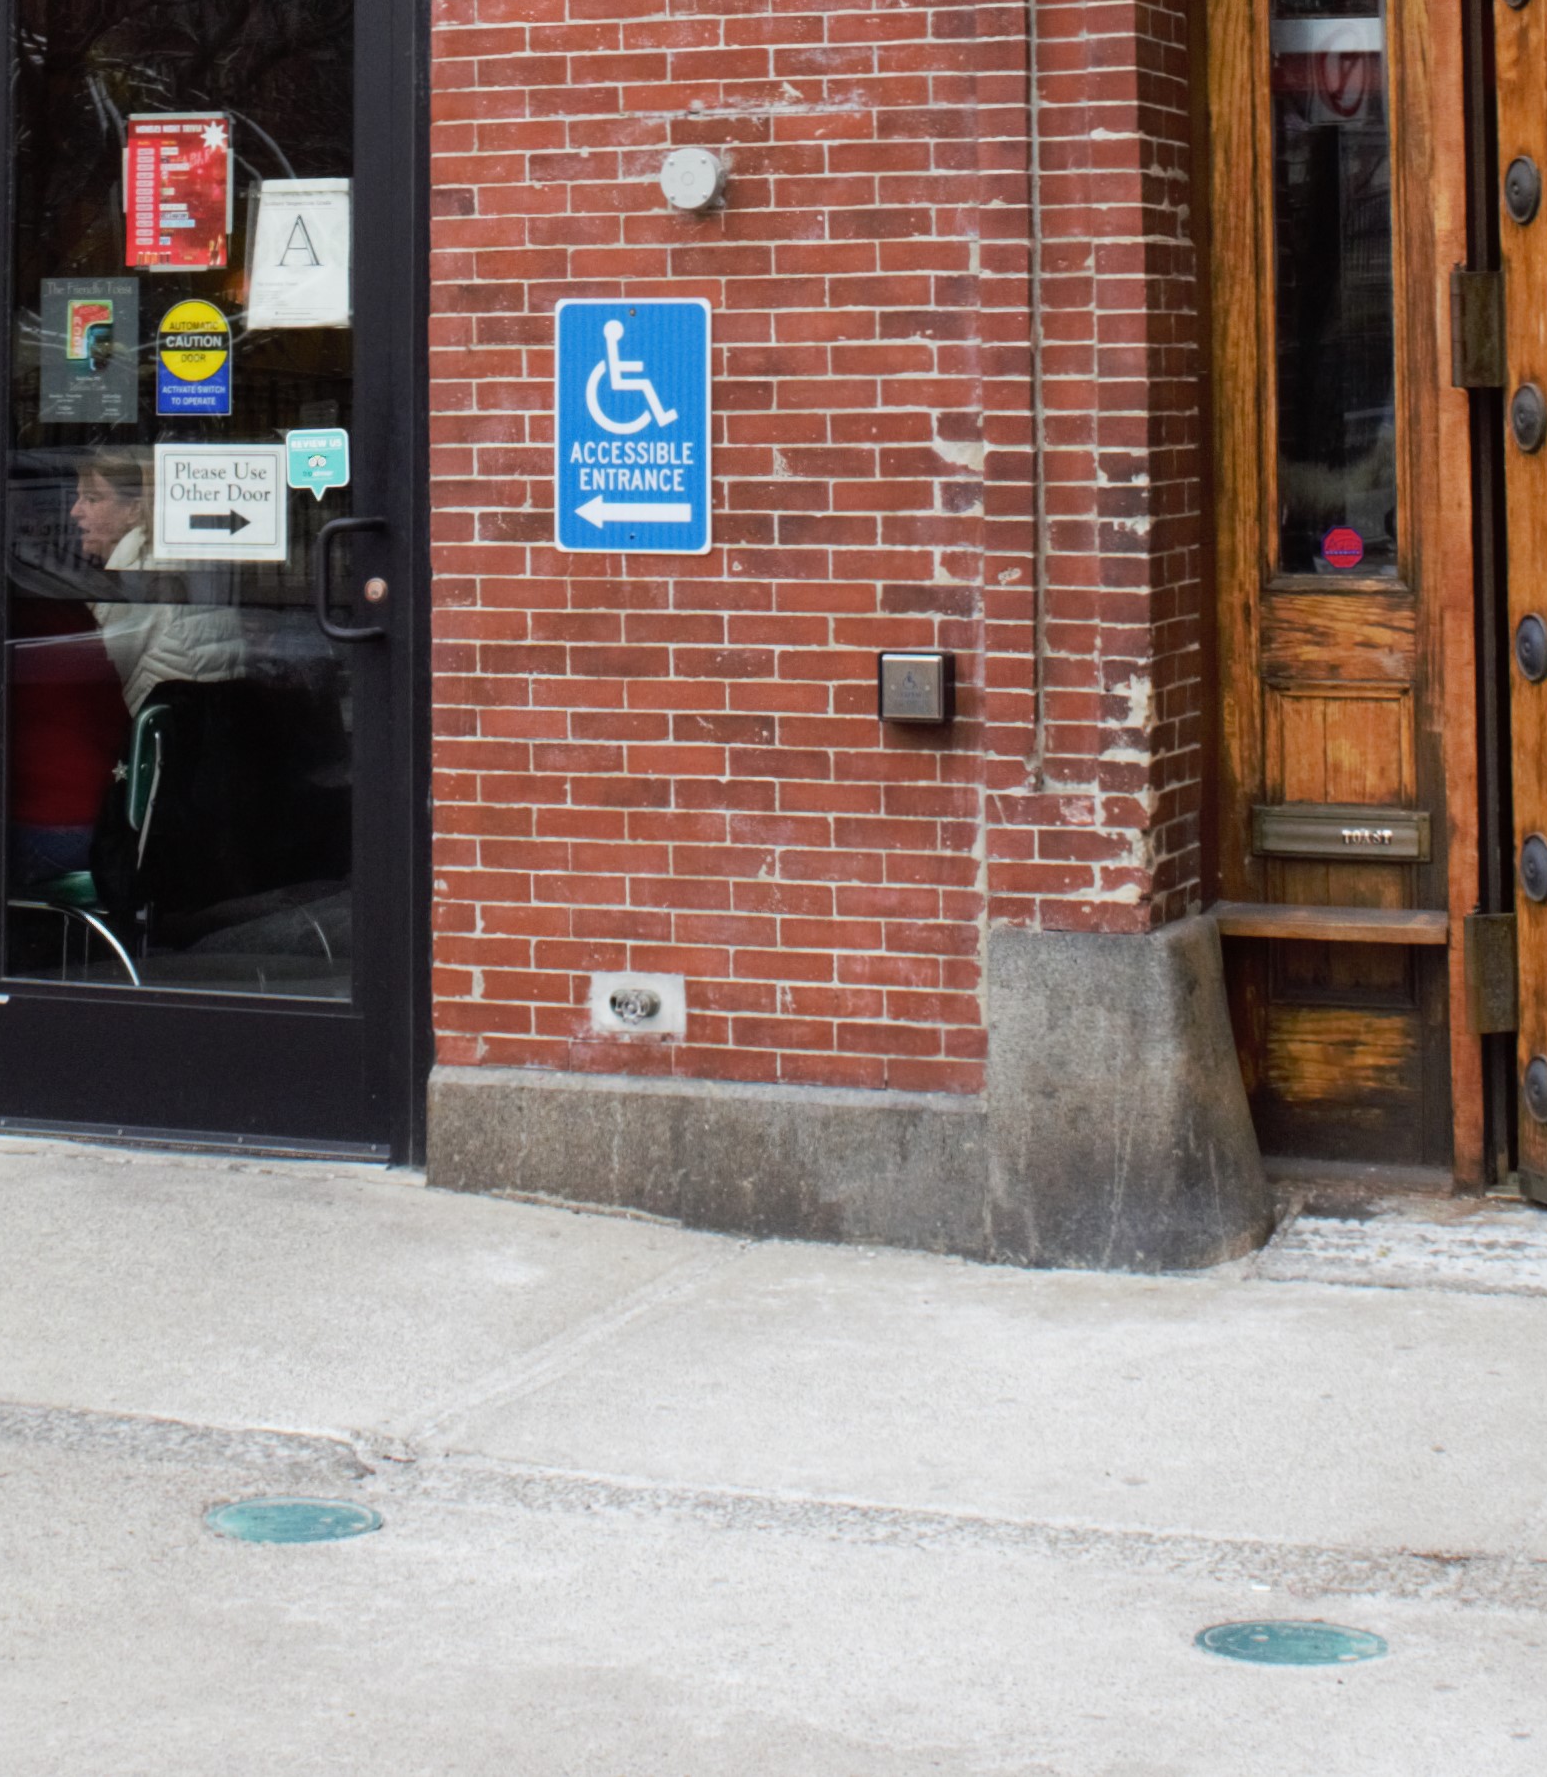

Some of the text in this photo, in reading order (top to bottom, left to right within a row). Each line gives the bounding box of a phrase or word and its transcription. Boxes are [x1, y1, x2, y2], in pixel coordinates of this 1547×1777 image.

[275, 214, 324, 267] A
[67, 281, 103, 295] Friendly
[169, 322, 218, 330] AUTOMATIC
[165, 335, 222, 348] CAUTION
[181, 353, 206, 363] DOOR
[162, 385, 226, 394] ACTIVATE SWITCH
[171, 396, 216, 406] TO OPERATE
[291, 438, 327, 448] REVIEW
[570, 441, 694, 465] ACCESSIBLE
[174, 461, 267, 480] Please Use
[579, 468, 685, 492] ENTRANCE
[169, 482, 271, 502] Other Door
[1341, 827, 1394, 846] TOAST
